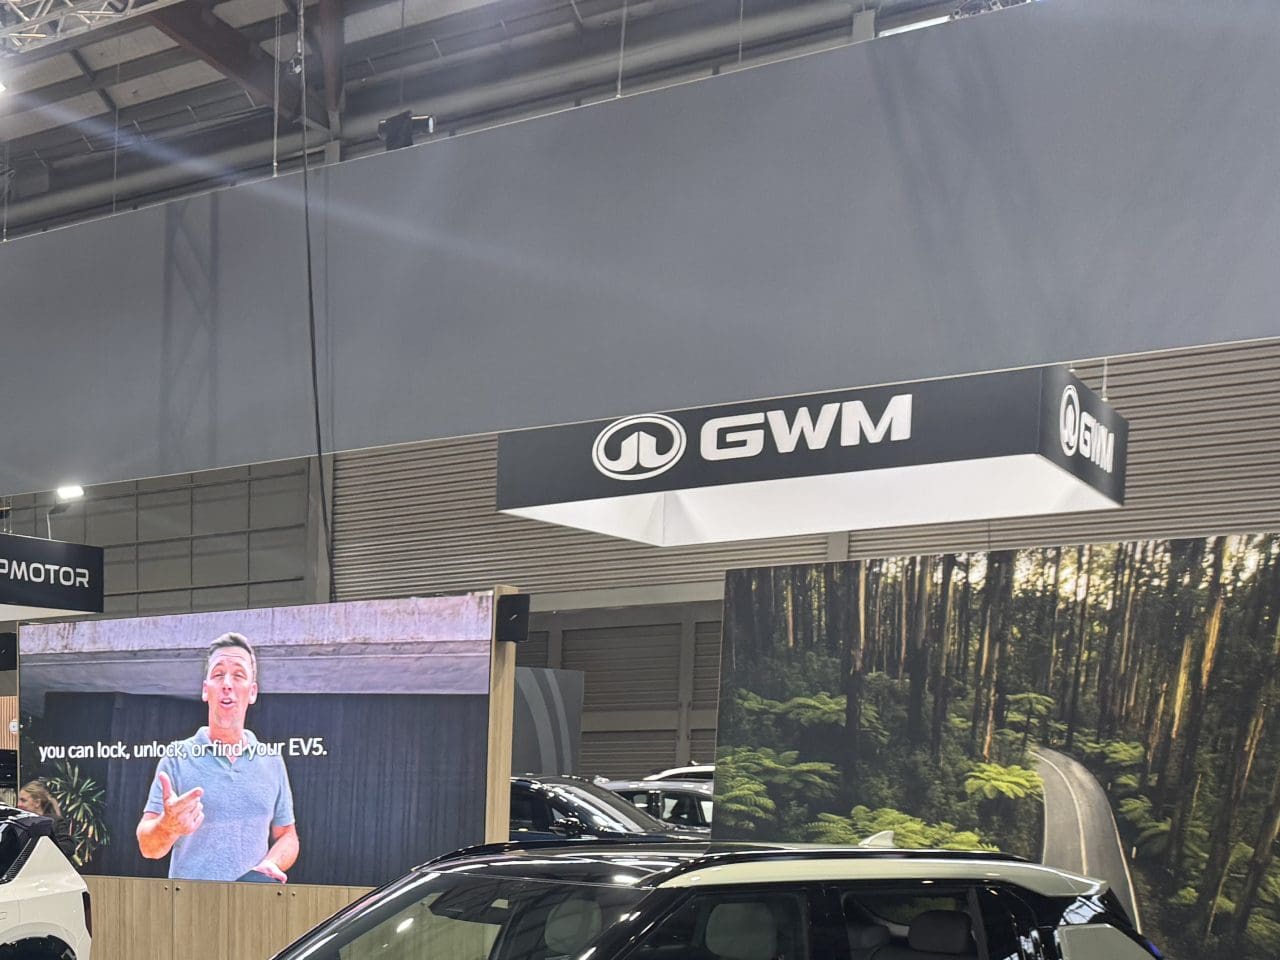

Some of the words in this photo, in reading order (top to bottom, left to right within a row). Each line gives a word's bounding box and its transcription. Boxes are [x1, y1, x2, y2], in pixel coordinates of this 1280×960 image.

[699, 393, 913, 462] GWM
[1078, 411, 1115, 474] GWM
[39, 745, 66, 763] you
[68, 744, 91, 759] can
[97, 741, 131, 760] lock,
[133, 740, 188, 760] unlock,
[191, 744, 207, 758] or
[212, 739, 243, 757] find
[248, 741, 285, 761] your
[289, 737, 328, 757] EV5.
